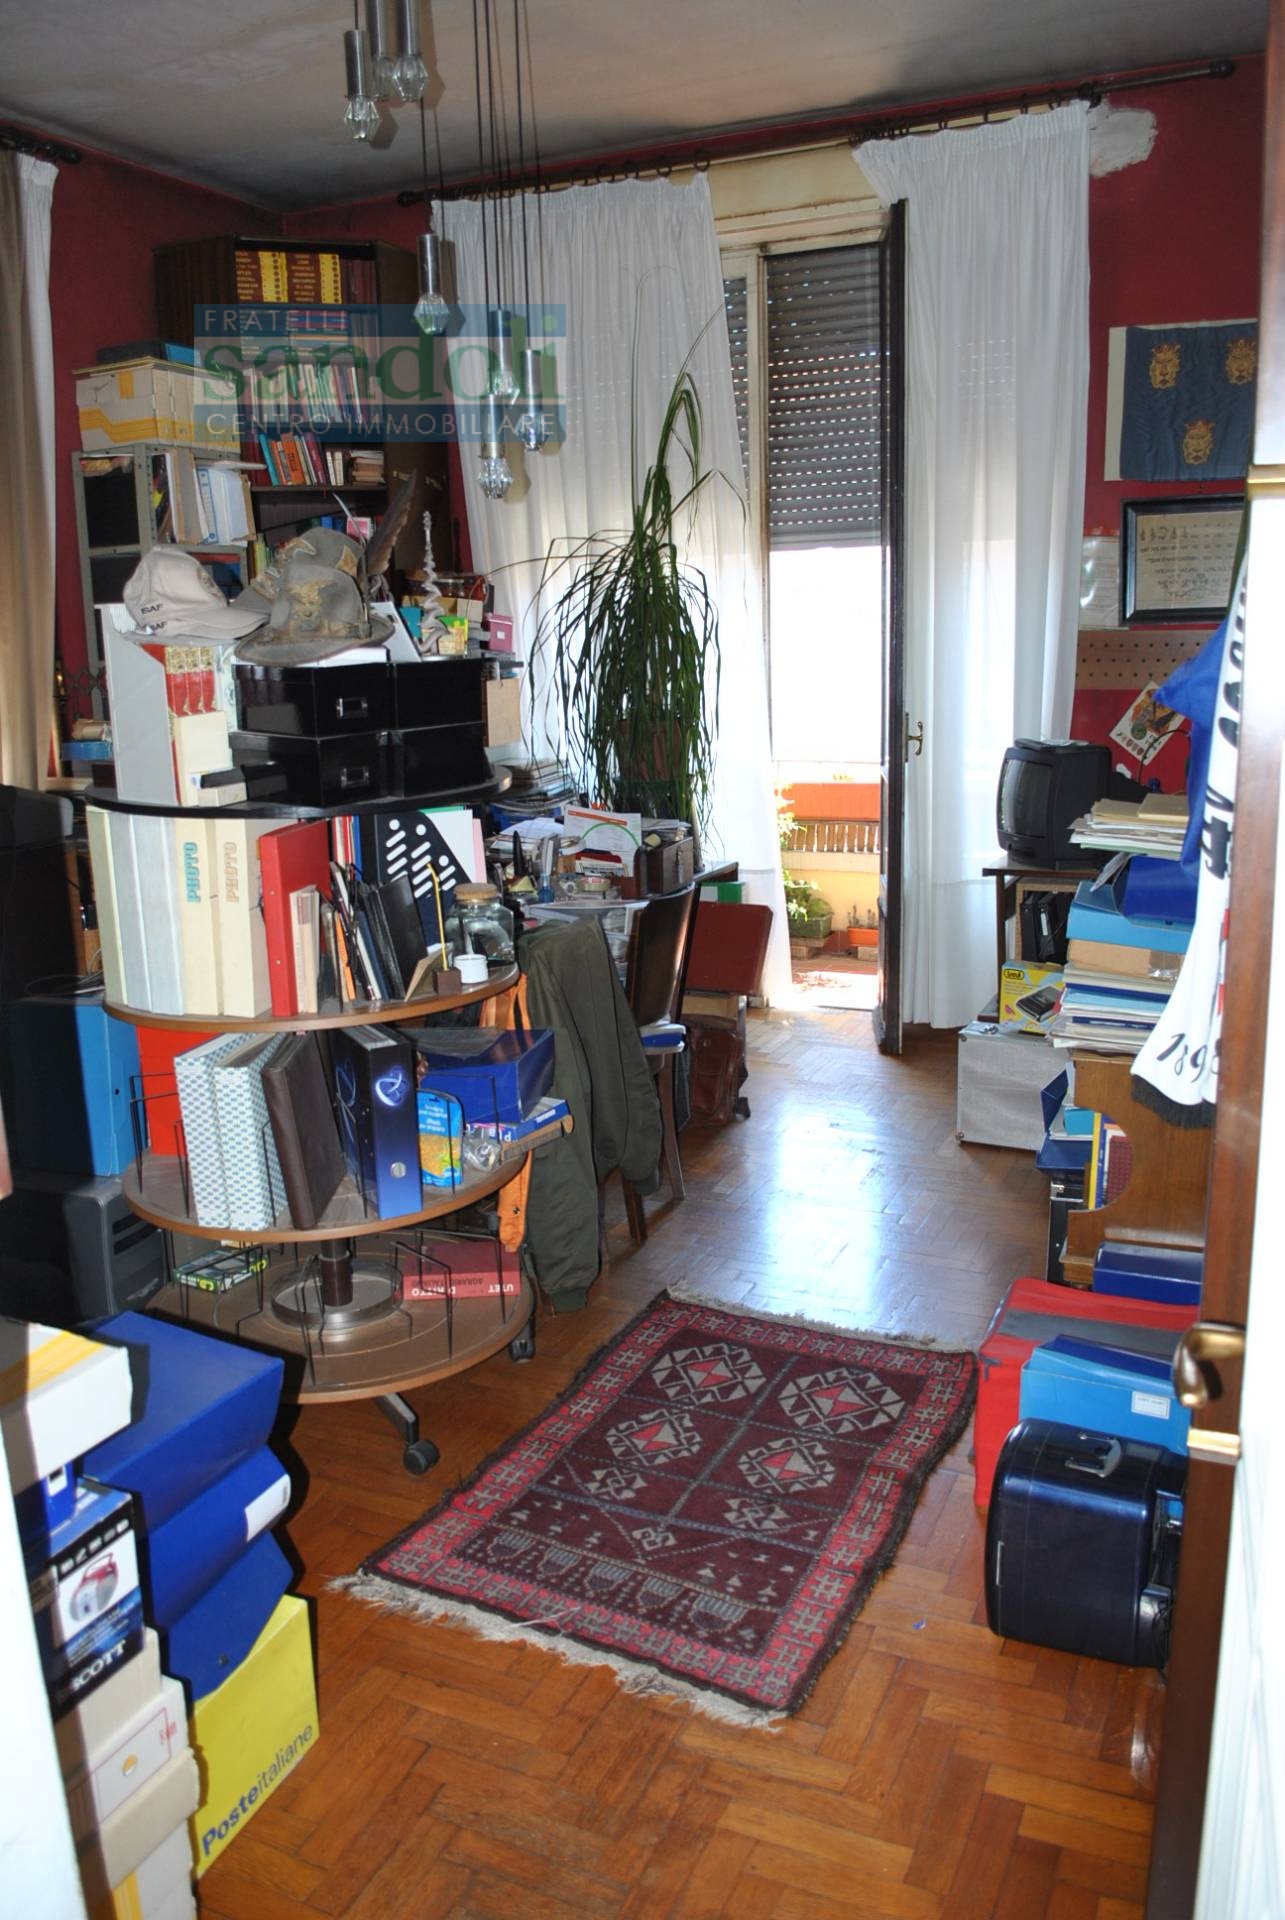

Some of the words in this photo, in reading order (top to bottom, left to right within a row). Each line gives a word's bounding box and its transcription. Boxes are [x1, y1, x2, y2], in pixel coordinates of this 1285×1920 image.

[183, 841, 201, 903] PHOTO
[224, 841, 239, 903] PHOTO
[71, 1640, 127, 1691] SCOTT
[202, 1724, 313, 1857] Posteitaliane
